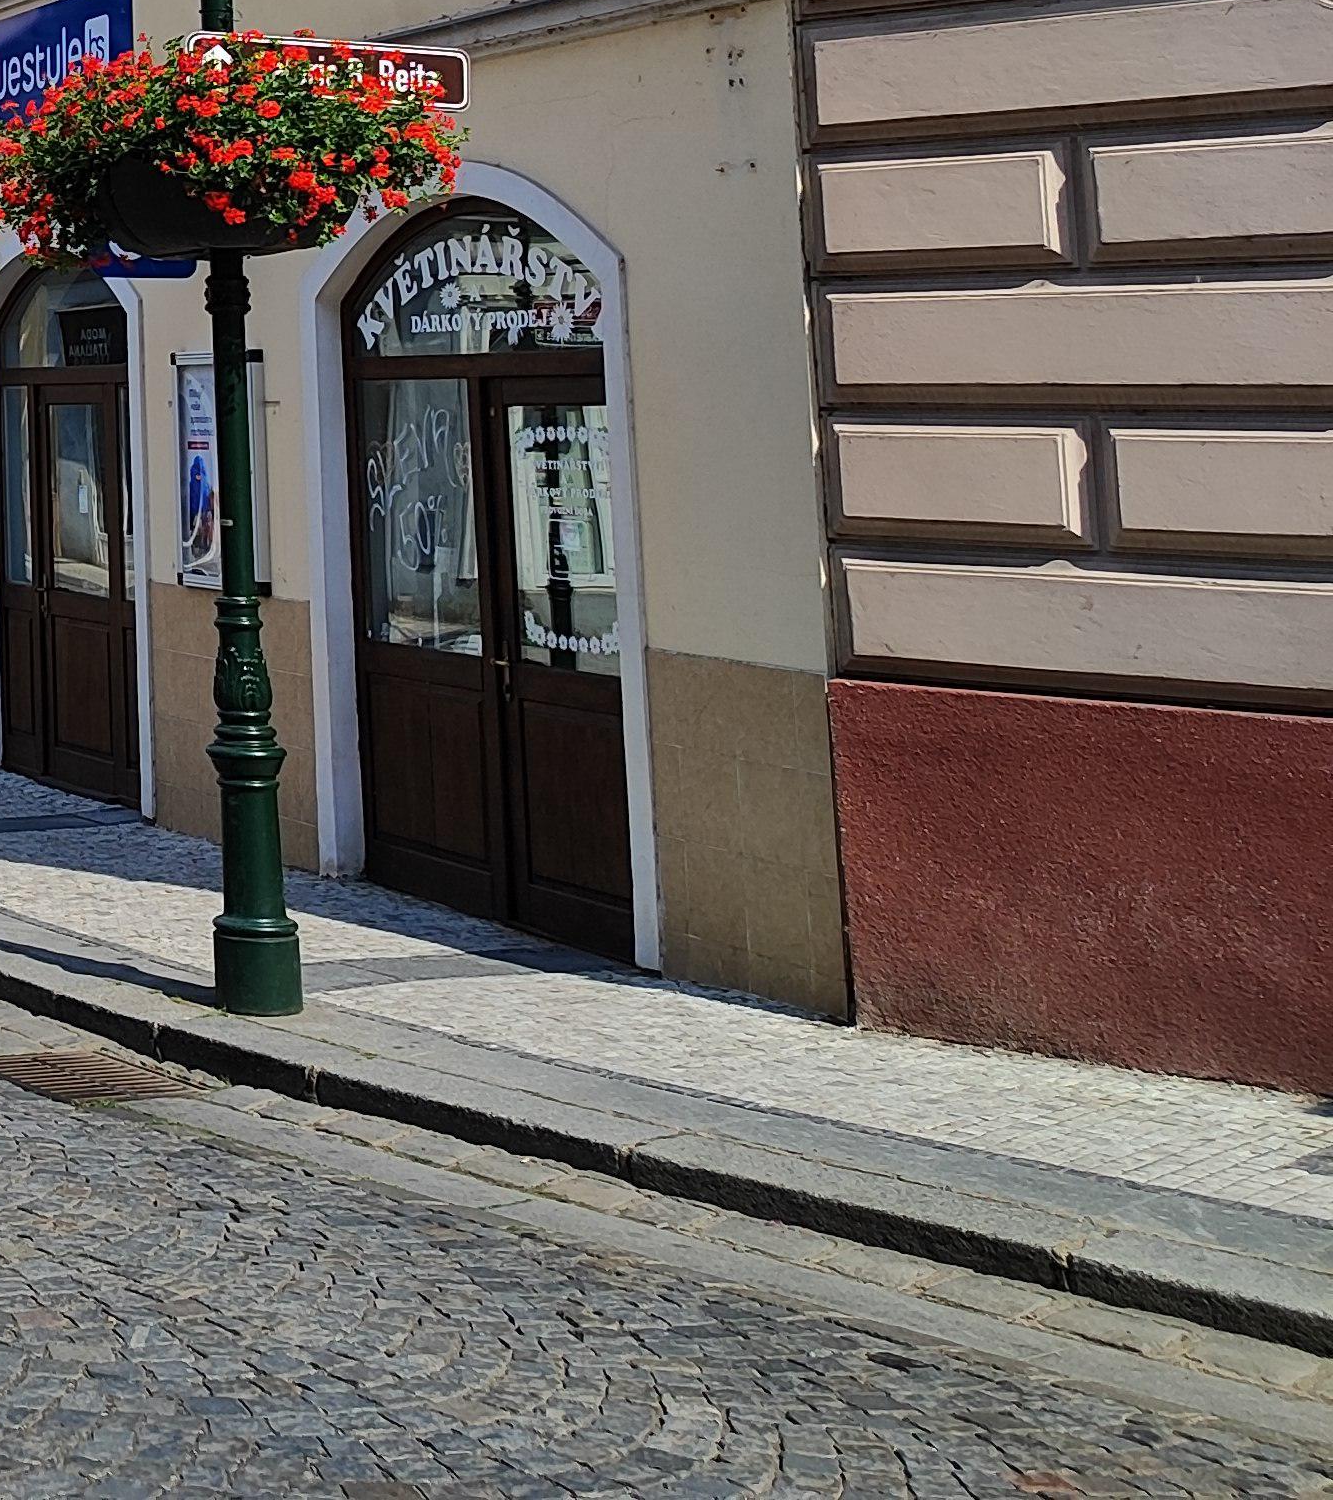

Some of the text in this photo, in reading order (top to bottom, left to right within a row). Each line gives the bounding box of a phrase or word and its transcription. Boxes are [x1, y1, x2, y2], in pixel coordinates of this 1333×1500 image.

[357, 224, 602, 350] KVĚTINÁŘSTV
[410, 308, 551, 333] DÁRKOVÝ PRODEJ
